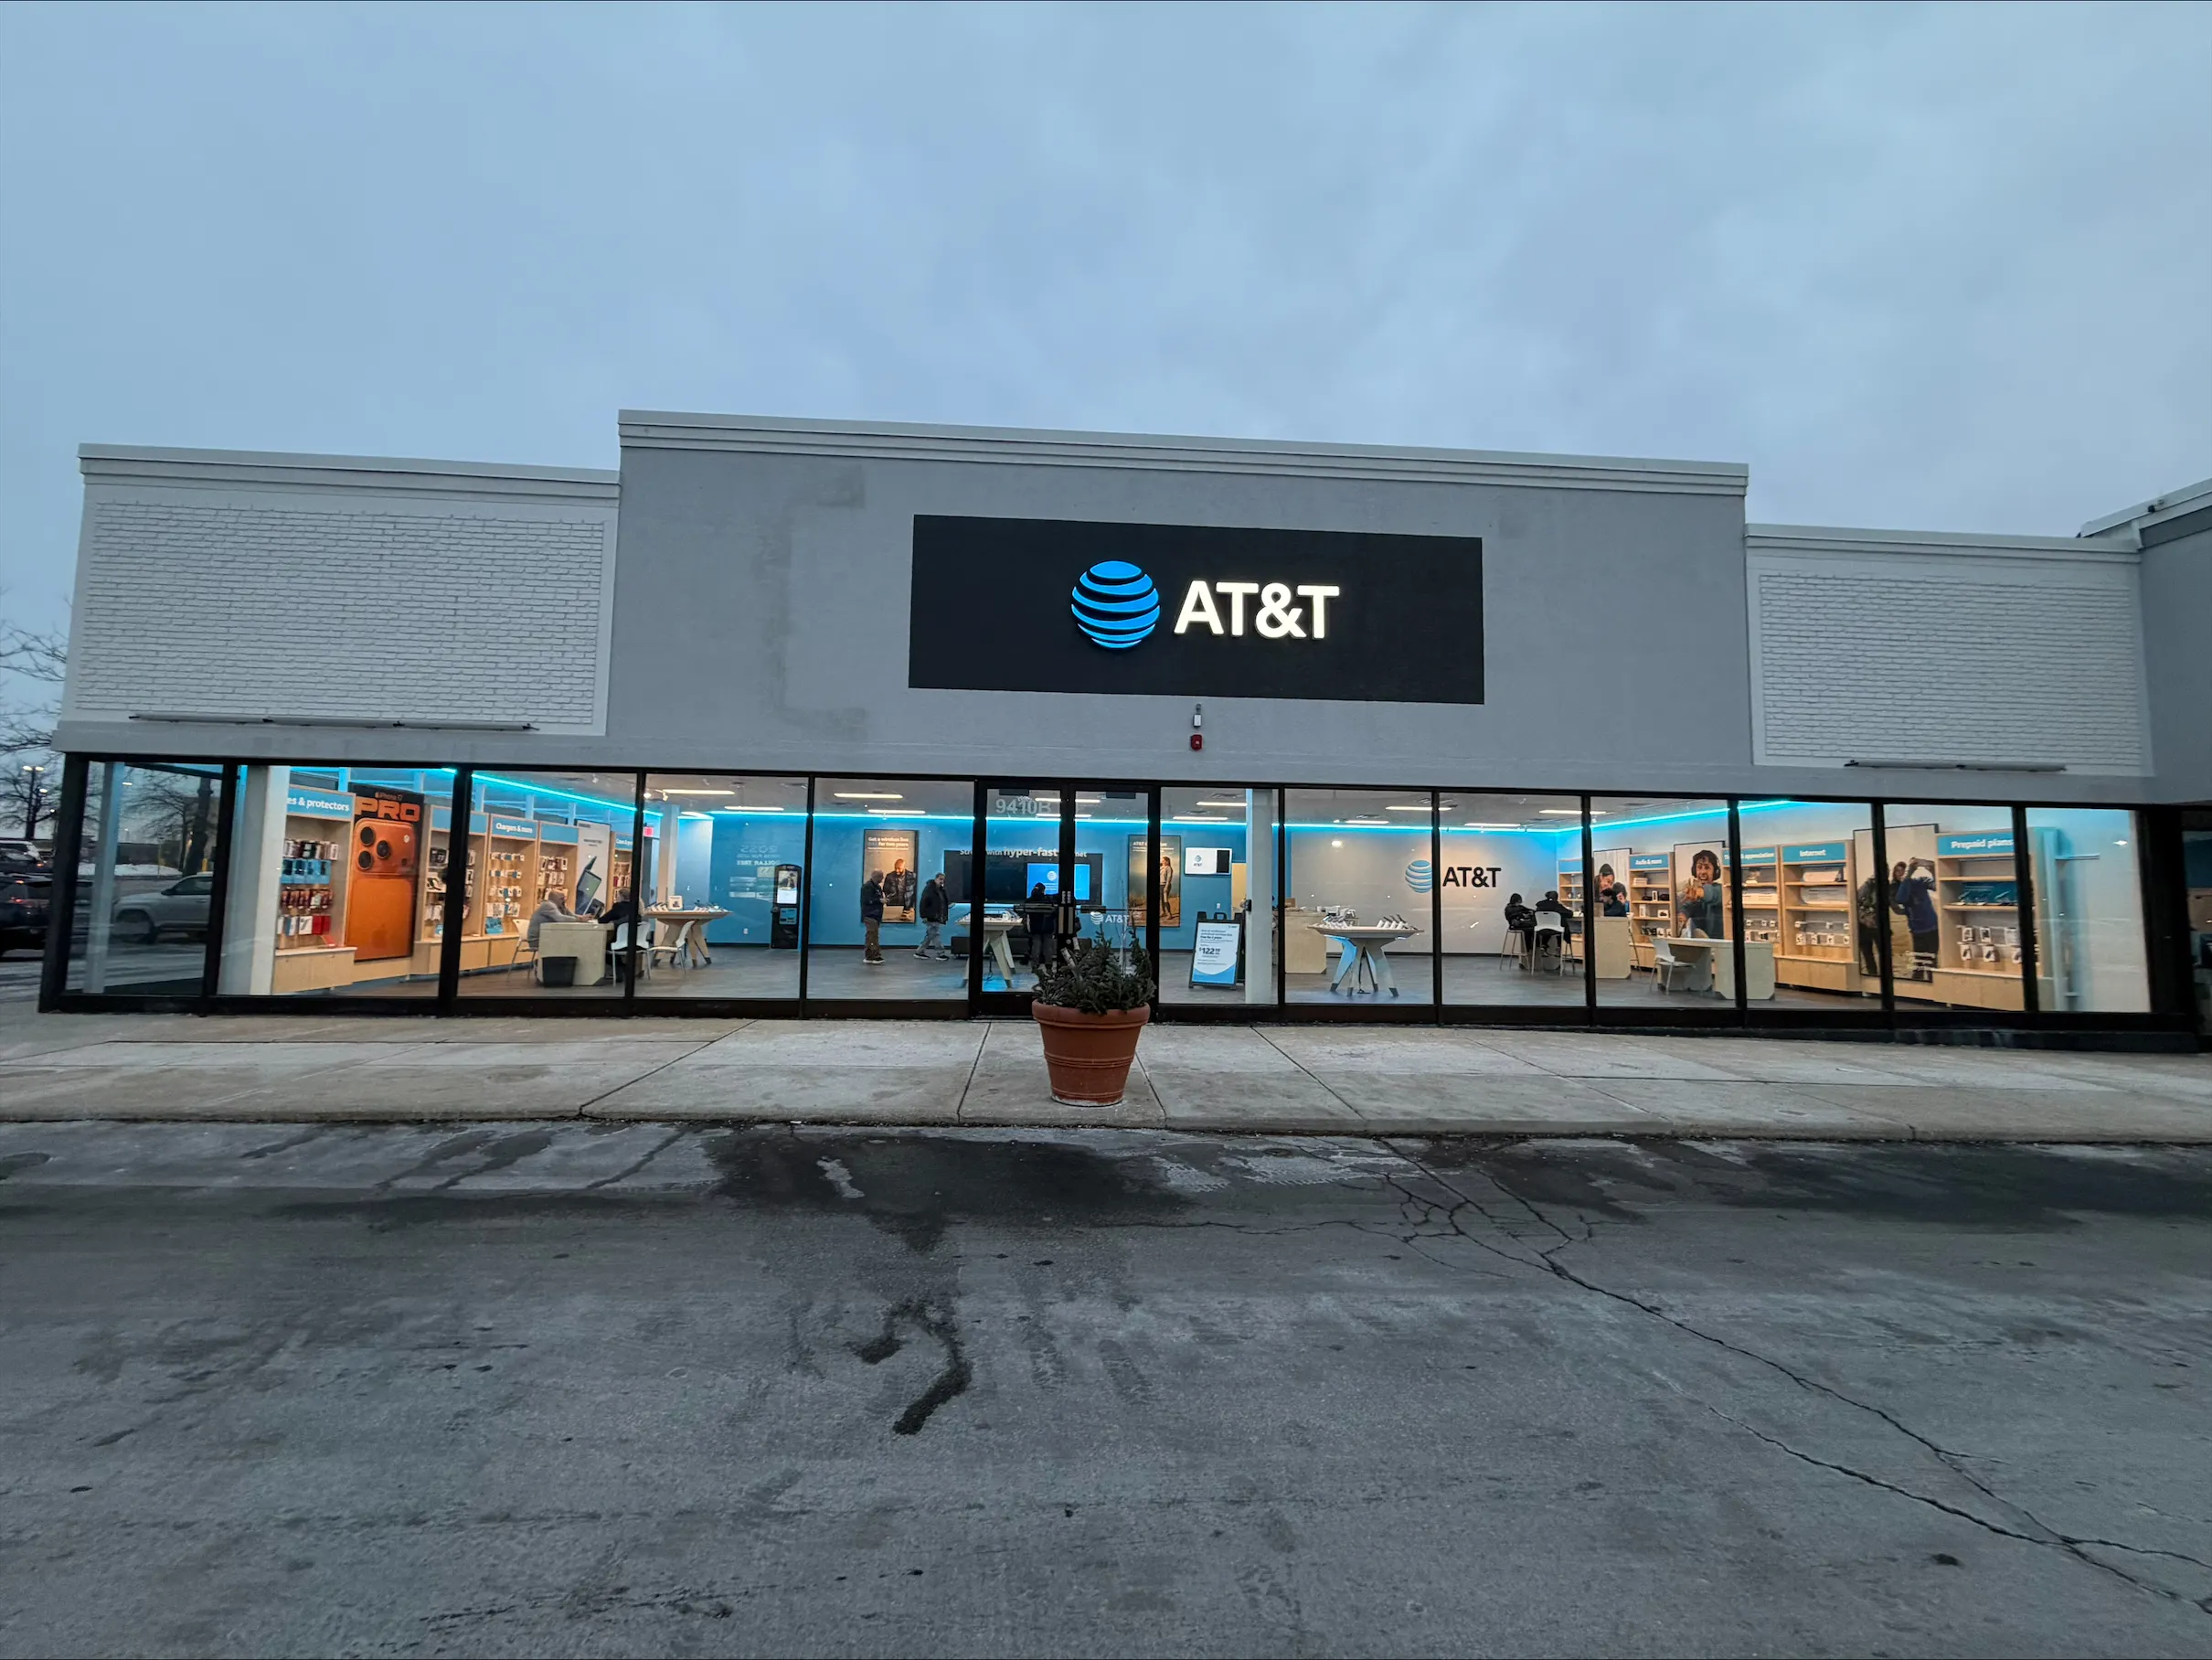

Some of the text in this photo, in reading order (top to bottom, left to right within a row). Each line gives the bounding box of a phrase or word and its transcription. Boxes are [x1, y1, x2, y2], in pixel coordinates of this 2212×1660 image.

[1174, 580, 1340, 639] AT&T
[298, 797, 306, 806] &
[306, 800, 350, 812] protectors
[355, 796, 420, 822] PRO
[1951, 839, 1985, 849] Prepaid
[1003, 846, 1058, 857] hyper-fast
[1800, 849, 1826, 857] Internet
[1441, 867, 1502, 888] AT&T
[1105, 914, 1130, 923] AT&T
